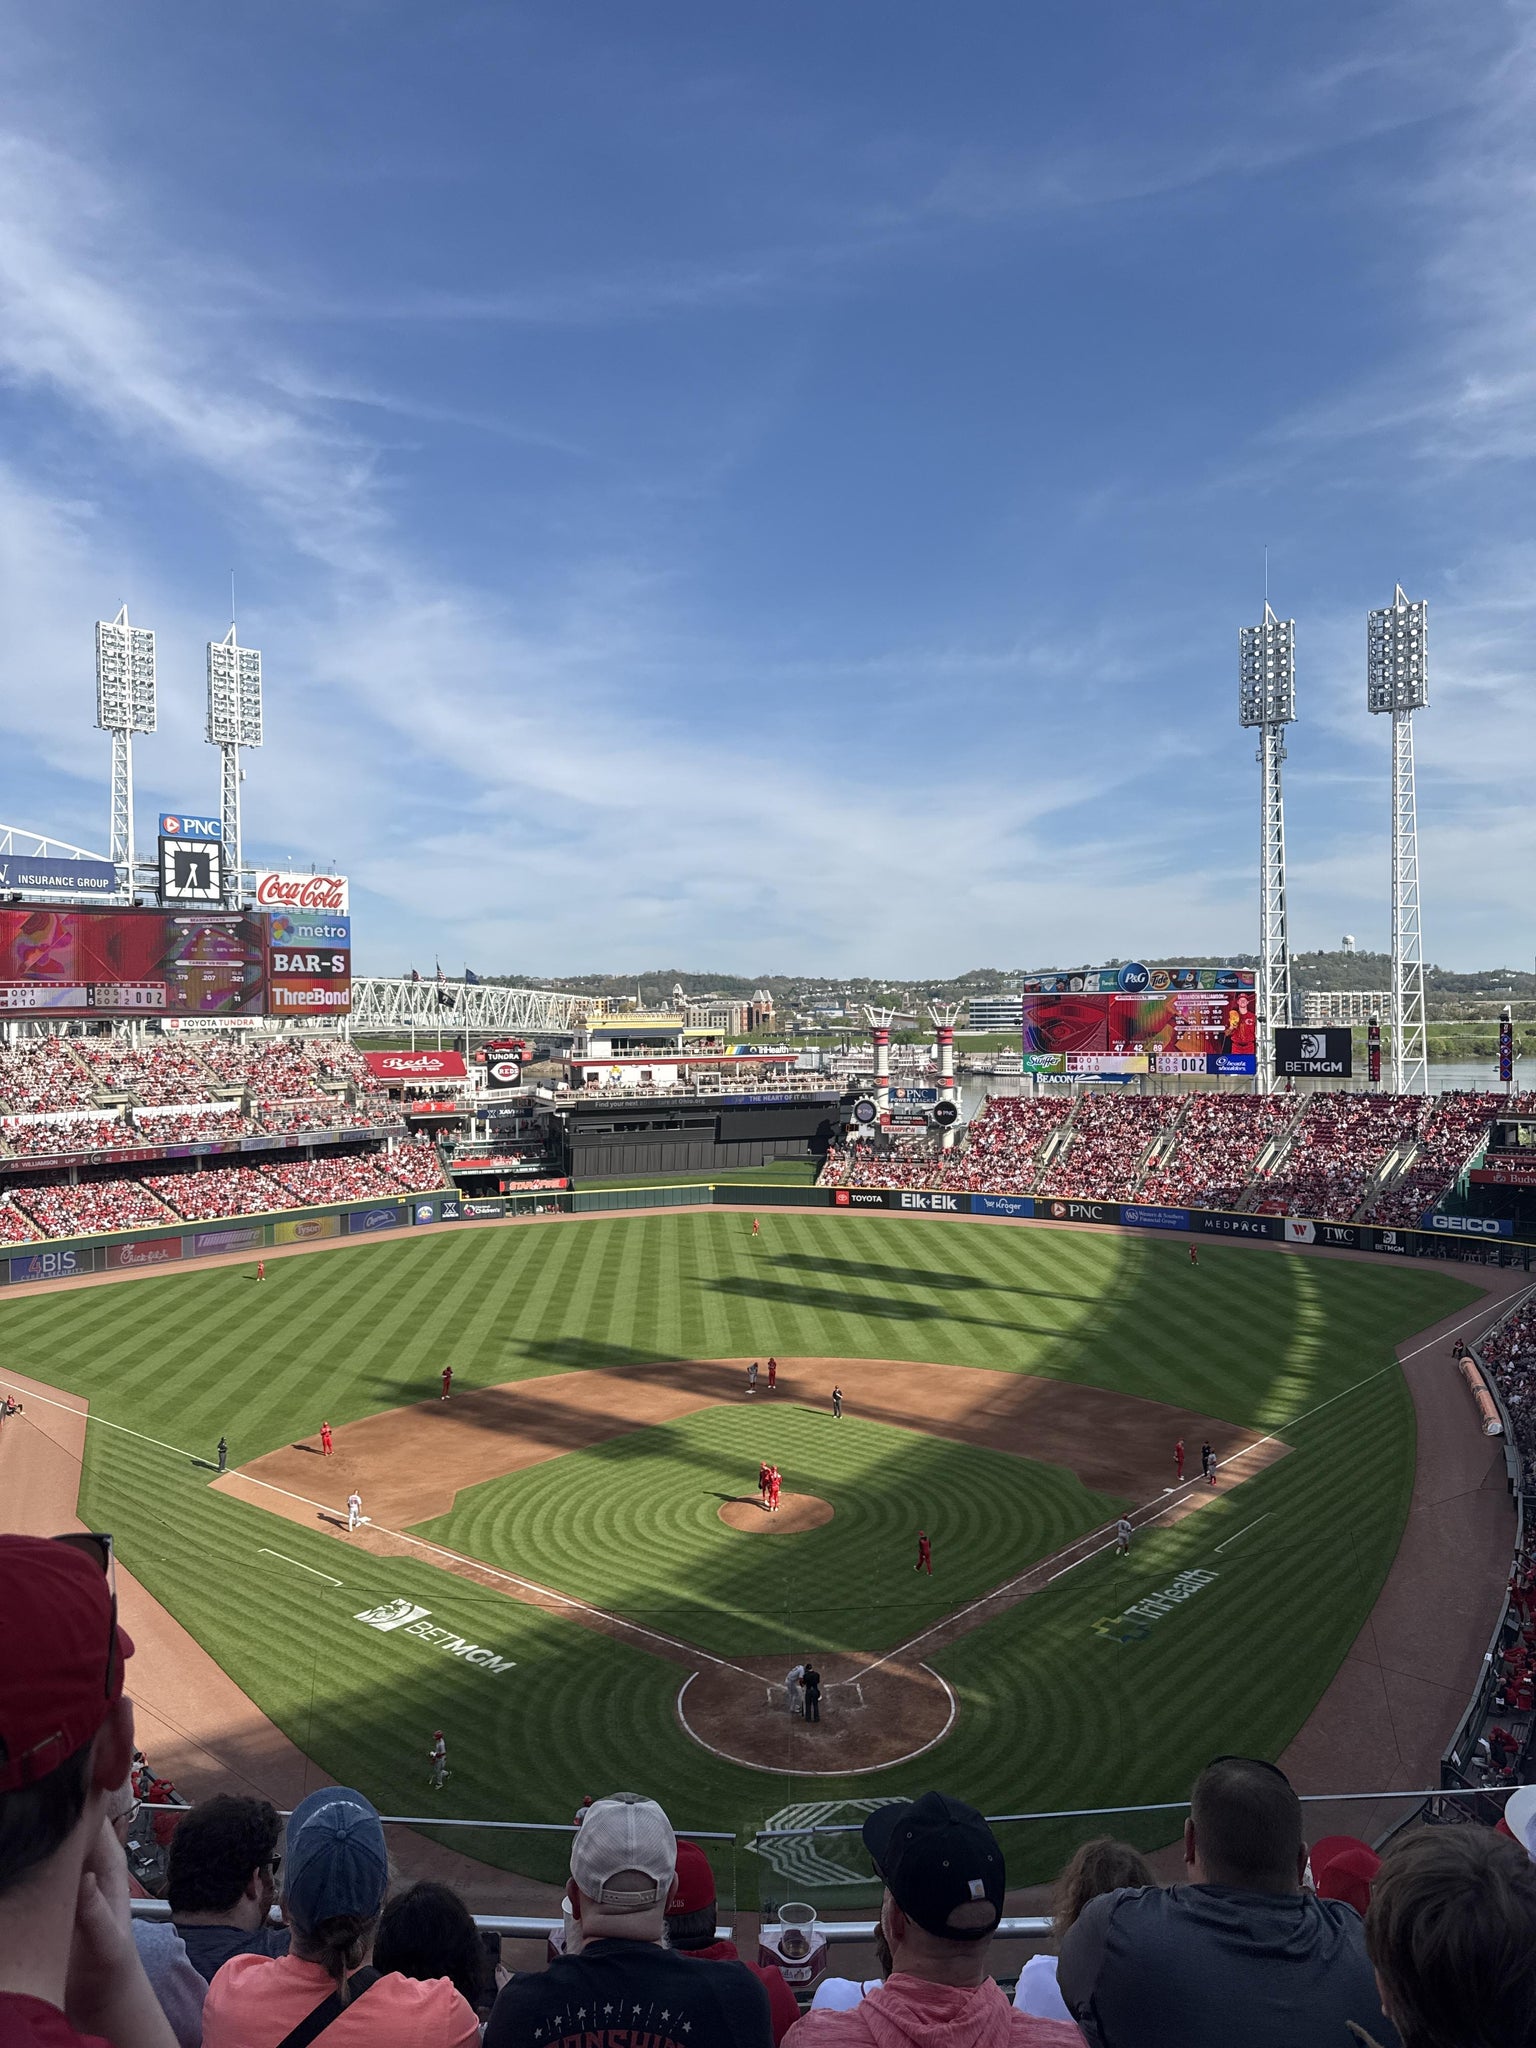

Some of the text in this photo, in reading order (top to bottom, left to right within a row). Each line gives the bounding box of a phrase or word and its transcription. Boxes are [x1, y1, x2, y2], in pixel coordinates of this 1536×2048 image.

[183, 818, 221, 836] PNC
[18, 874, 74, 887] INSURANCE
[77, 877, 109, 888] GROUP
[258, 874, 347, 908] Coca-Cola
[298, 925, 347, 938] metro
[274, 954, 345, 973] BAR-S
[1125, 972, 1146, 984] P&G
[1151, 974, 1169, 986] Tide
[157, 992, 162, 1004] 2
[272, 988, 350, 1005] ThreeBond
[183, 1018, 254, 1027] TOYOTA TUNDRA
[758, 1044, 789, 1054] TriHealth
[1153, 1044, 1162, 1052] 89
[382, 1056, 444, 1070] Reds
[1027, 1054, 1060, 1068] Swiffer
[1285, 1061, 1343, 1072] BETMGM
[1036, 1074, 1075, 1084] BEACON
[906, 1090, 928, 1098] PNC
[22, 1160, 58, 1168] WILLIAMSON
[852, 1194, 882, 1202] TOYOTA
[996, 1199, 1021, 1214] Kroger
[1069, 1204, 1103, 1219] PNC
[1164, 1212, 1184, 1220] Southern
[296, 1224, 321, 1236] Tyson
[1204, 1220, 1268, 1233] MEDPACE
[1432, 1216, 1500, 1233] GEICO
[1323, 1226, 1354, 1242] TWC
[1375, 1244, 1404, 1253] BETMGM
[28, 1251, 77, 1274] 4BIS
[48, 1268, 84, 1277] SECURITY
[1123, 1568, 1220, 1620] TriHealth
[404, 1620, 518, 1674] BETMGM
